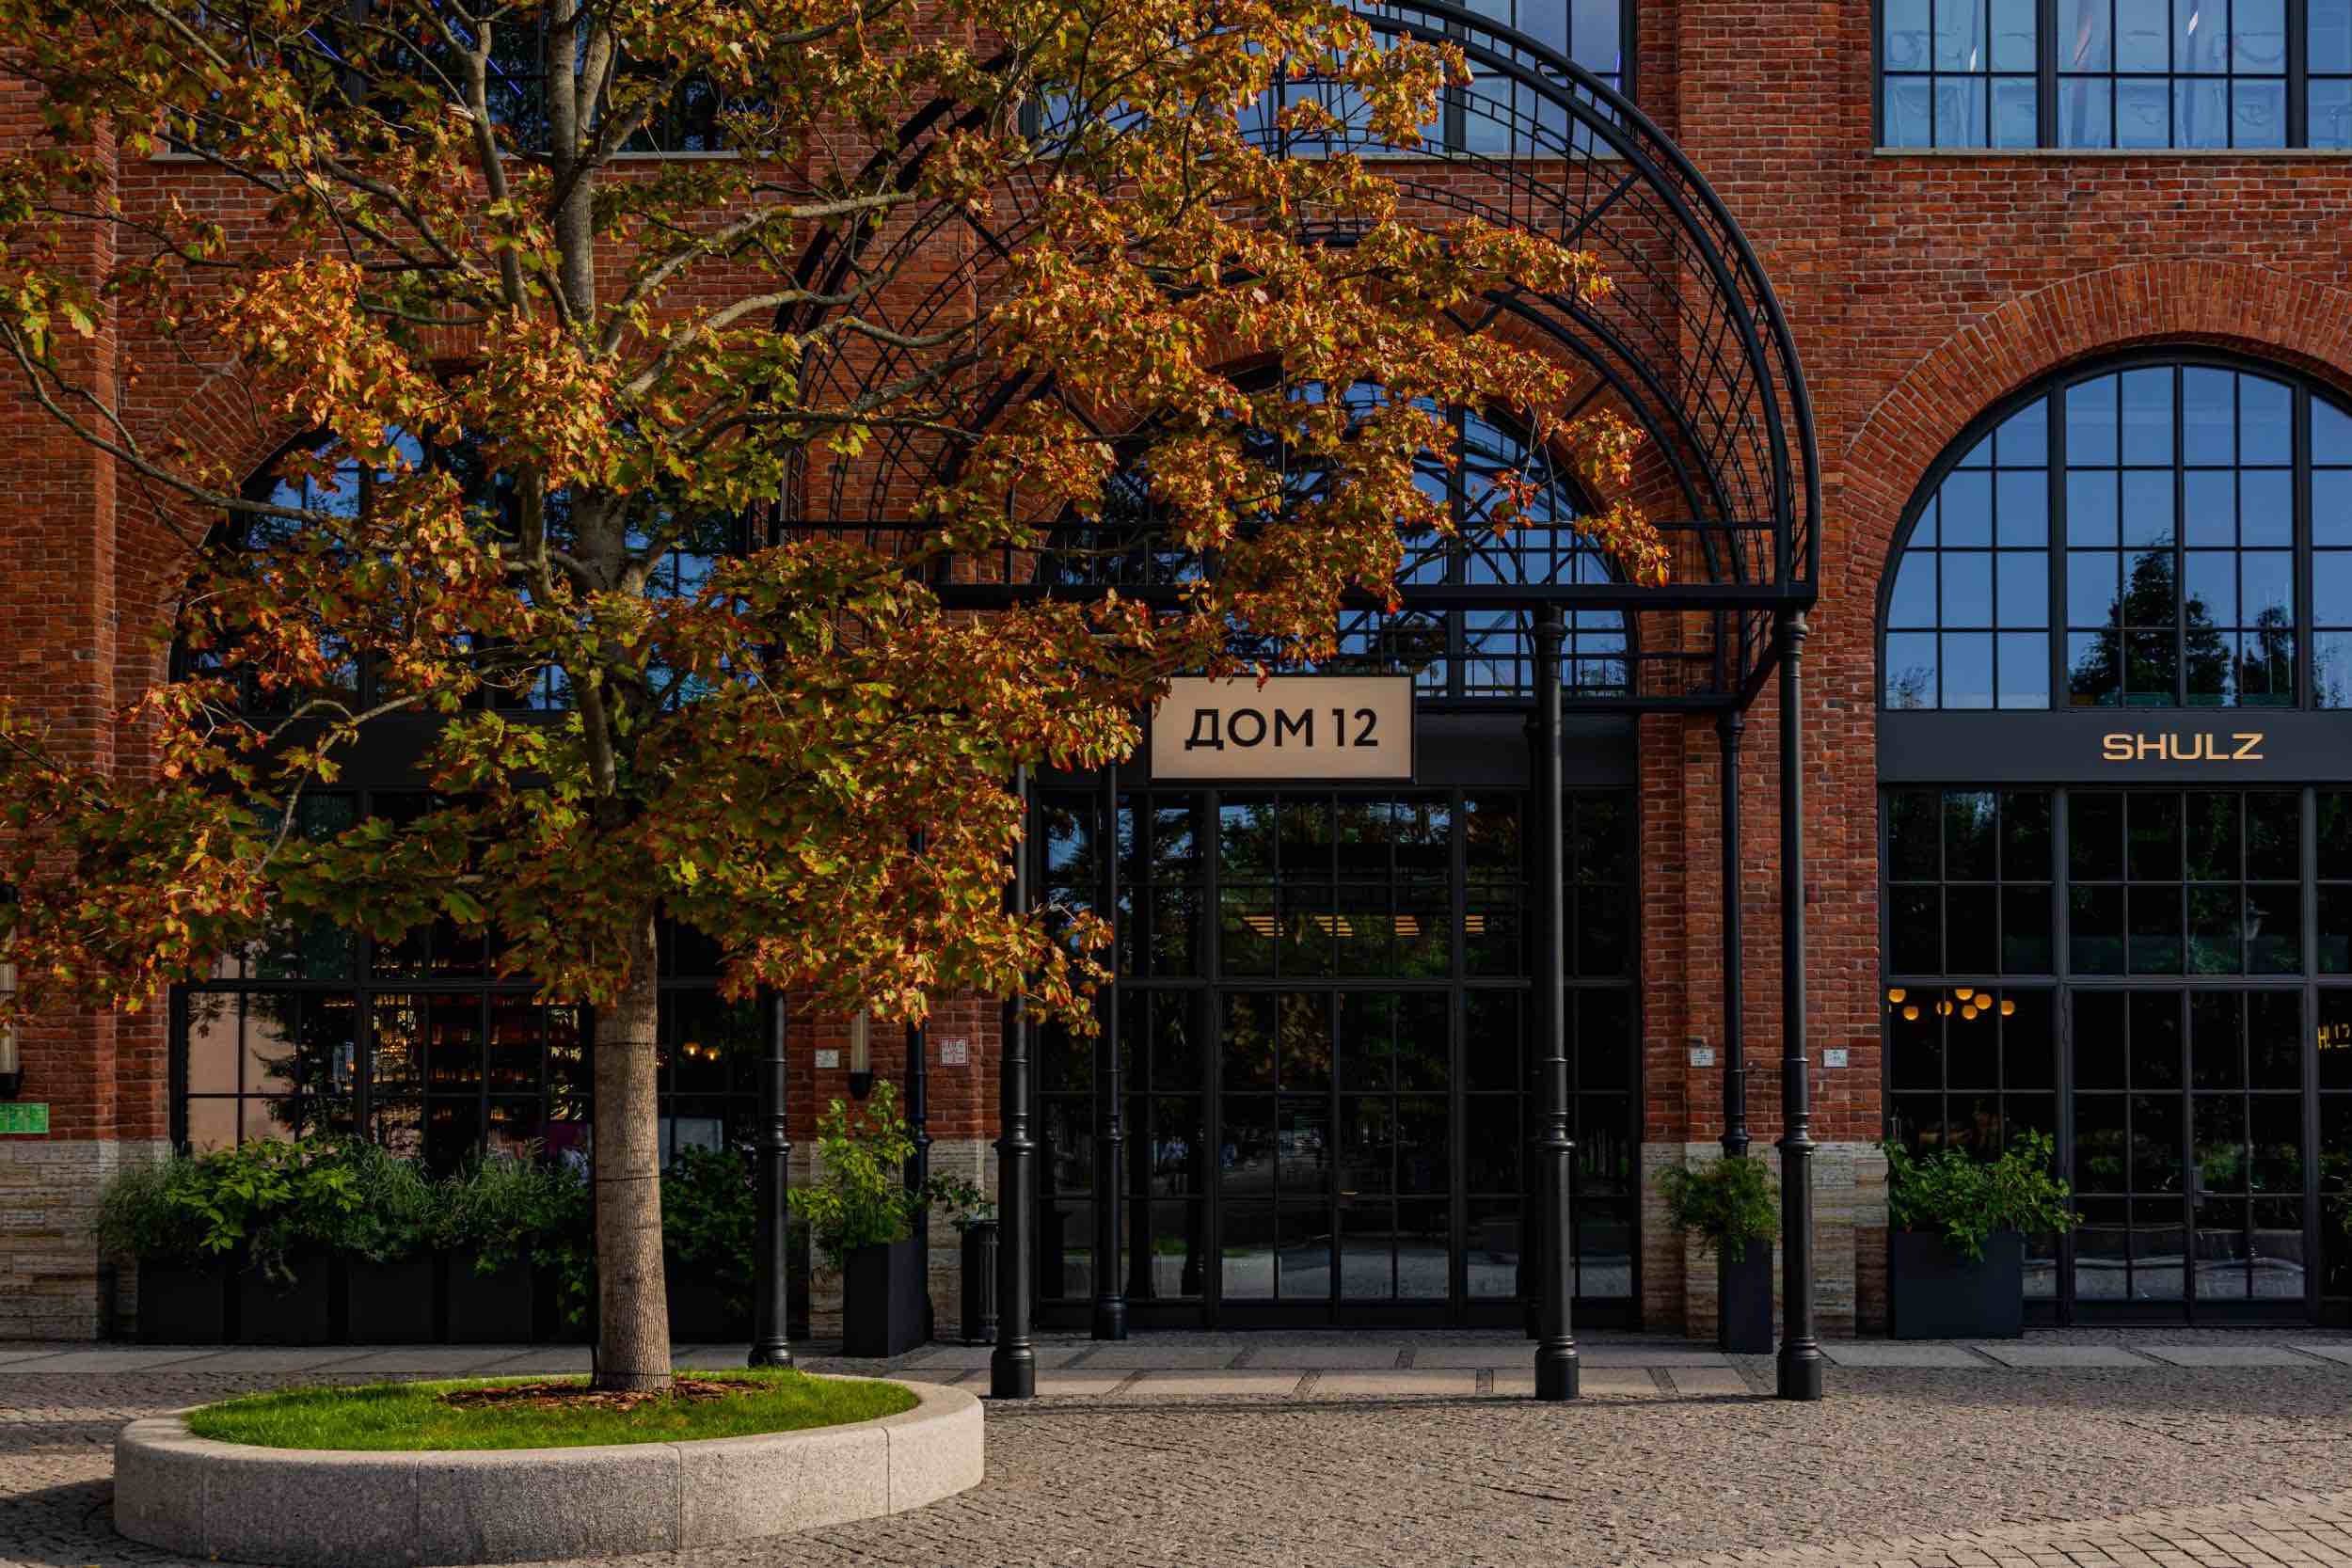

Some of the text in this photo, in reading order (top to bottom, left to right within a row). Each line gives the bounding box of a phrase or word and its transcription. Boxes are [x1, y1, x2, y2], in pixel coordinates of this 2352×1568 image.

[1184, 708, 1378, 751] ДОМ 12
[2102, 733, 2264, 759] SHULZ
